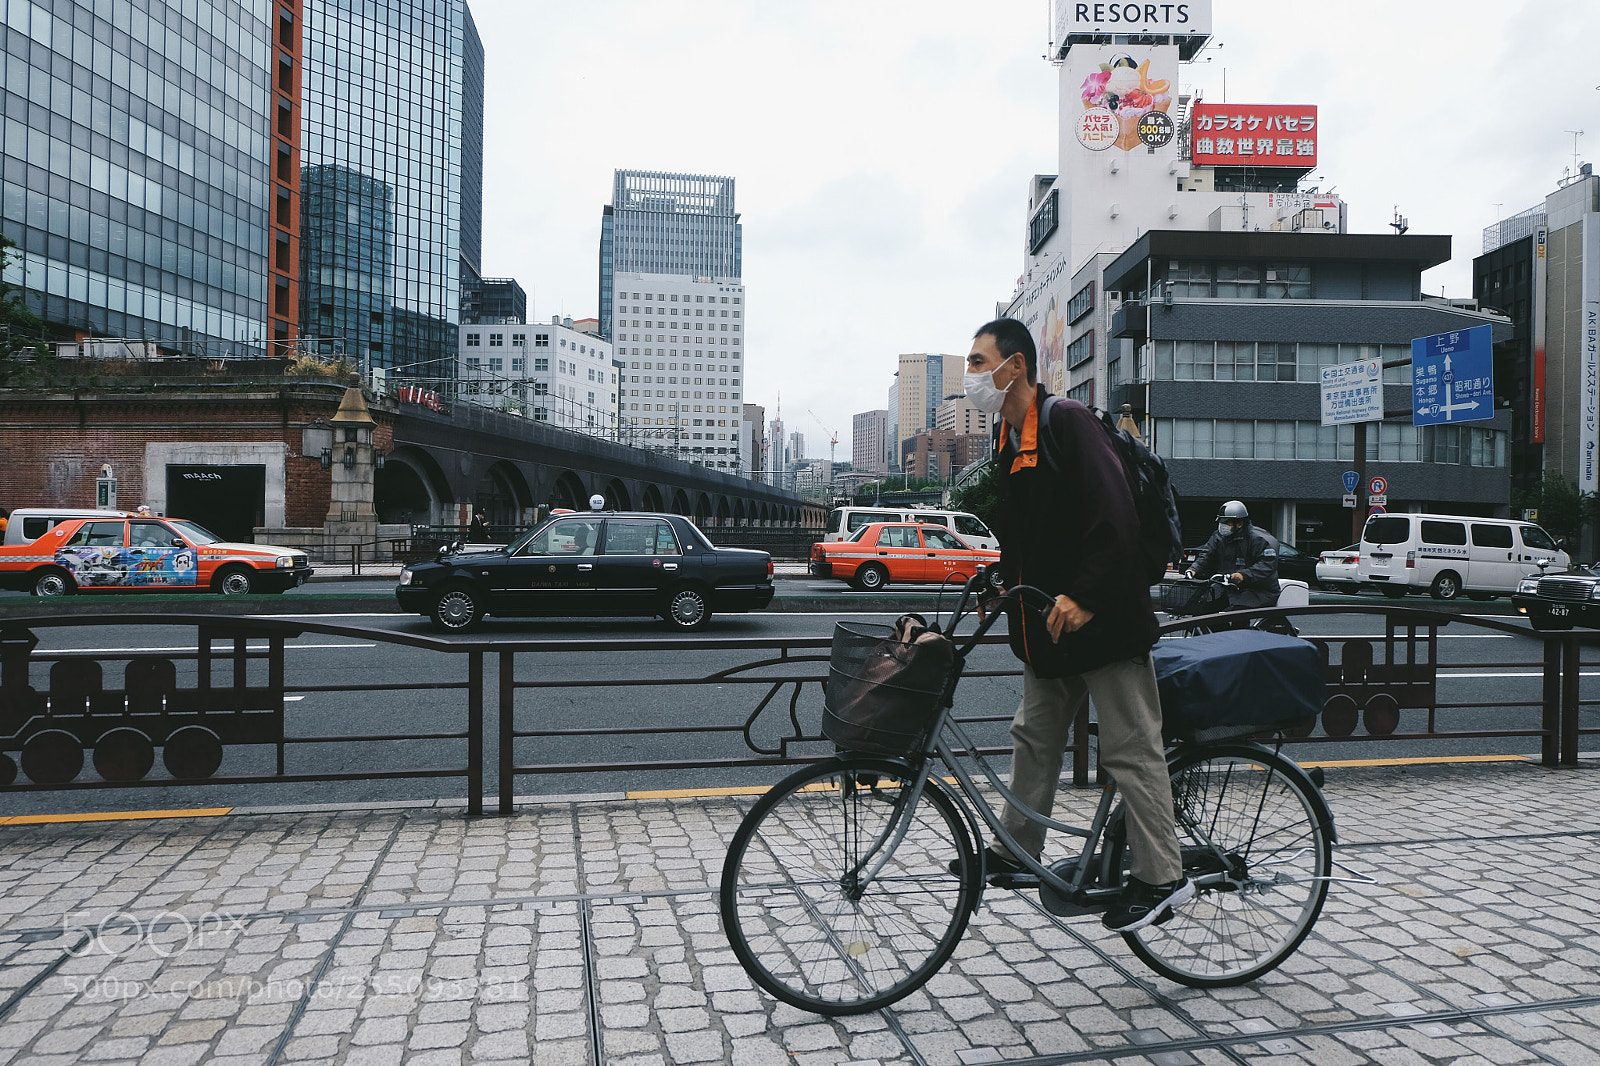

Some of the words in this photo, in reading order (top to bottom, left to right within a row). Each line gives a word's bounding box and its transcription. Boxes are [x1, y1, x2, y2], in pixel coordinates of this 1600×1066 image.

[1075, 3, 1189, 23] RESORTS
[1196, 137, 1315, 156] 曲数世界最強
[1435, 333, 1459, 347] 上野
[1416, 377, 1437, 385] Sugamo
[1455, 377, 1490, 392] 昭和通り
[1416, 385, 1438, 396] 本郷
[1347, 477, 1354, 485] 17
